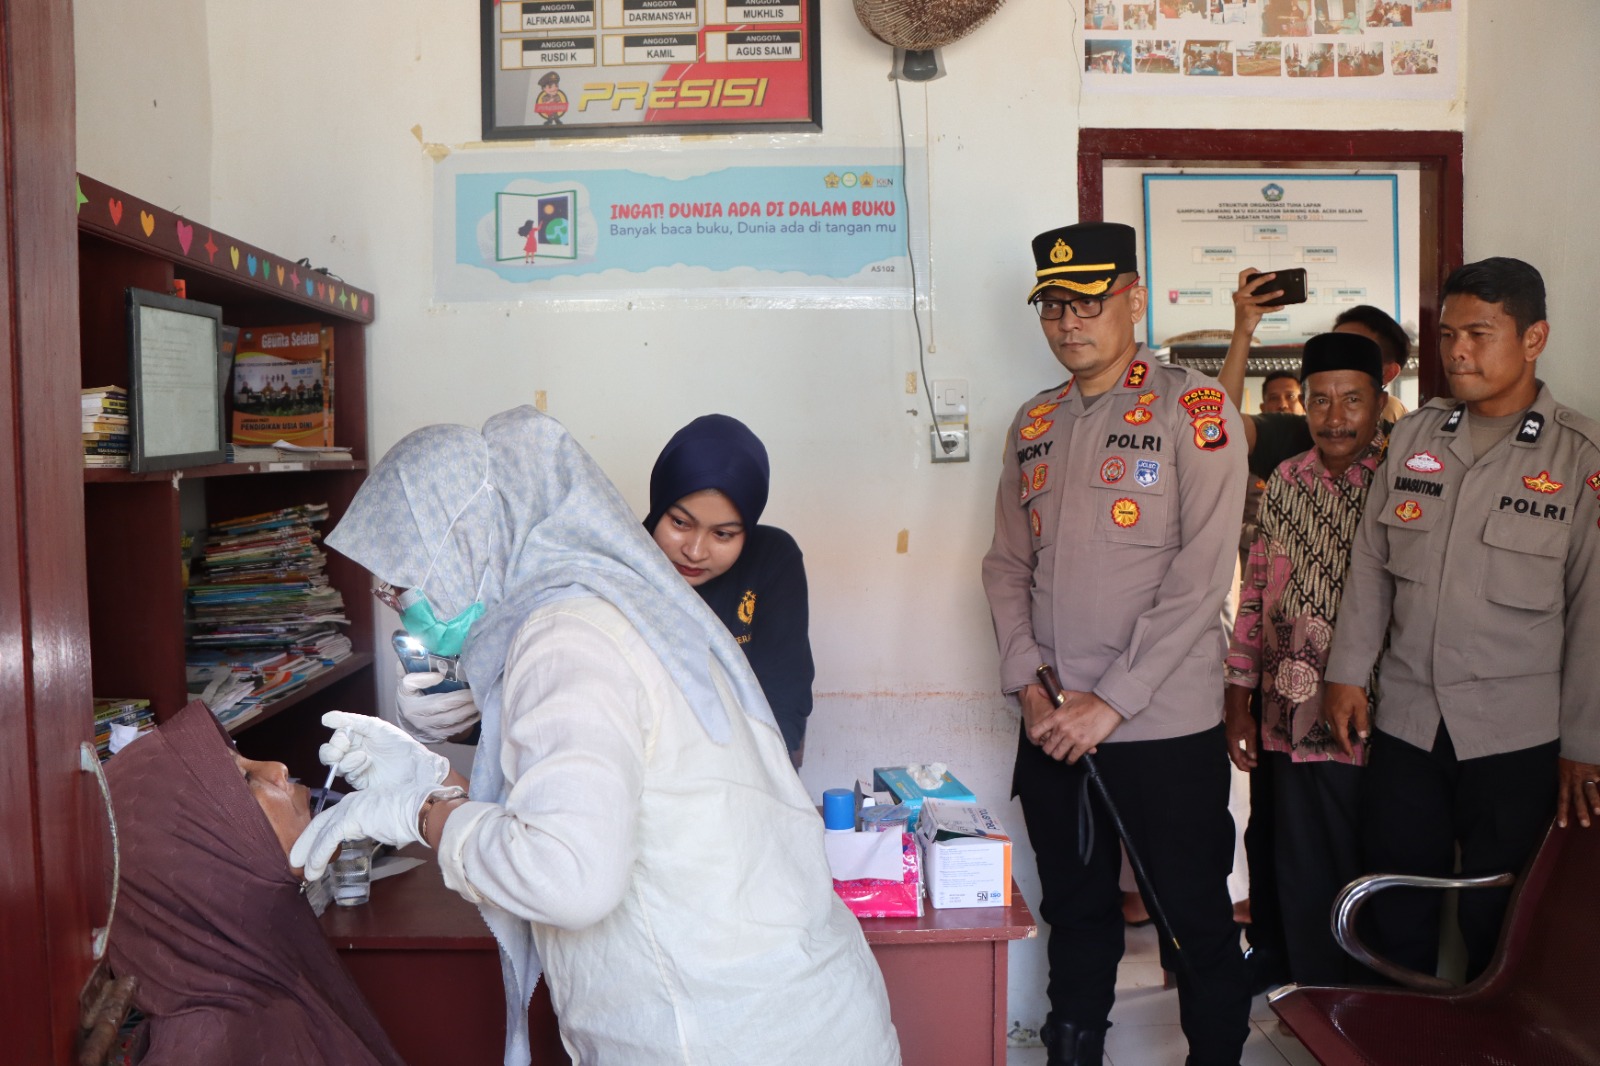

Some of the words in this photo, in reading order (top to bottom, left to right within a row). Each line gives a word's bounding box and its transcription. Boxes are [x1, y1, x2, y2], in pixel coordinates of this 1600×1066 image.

[629, 12, 692, 22] DARMANSYAH
[743, 9, 784, 18] MUKHLIS
[526, 16, 557, 25] ALFIKAR
[558, 15, 590, 24] AMANDA
[646, 49, 675, 58] KAMIL
[736, 47, 762, 56] AGUS
[764, 46, 792, 55] SALIM
[540, 53, 568, 62] RUSDI
[570, 52, 577, 61] K
[578, 78, 769, 112] PRESISI
[610, 203, 664, 220] INGAT!
[669, 202, 722, 218] DUNIA
[728, 202, 761, 218] ADA
[766, 201, 784, 217] DI
[789, 200, 847, 217] DALAM
[852, 200, 896, 216] BUKU
[610, 223, 656, 238] Banyak
[661, 222, 692, 234] baca
[696, 222, 733, 236] buku,
[738, 221, 776, 234] Dunia
[780, 221, 804, 233] ada
[808, 221, 822, 232] di
[826, 222, 872, 236] tangan
[876, 223, 896, 232] mu
[291, 332, 319, 346] Selatan
[1184, 390, 1221, 402] POLRES
[1194, 405, 1218, 414] ACEH
[1106, 434, 1162, 452] POLRI
[1500, 496, 1566, 520] POLRI
